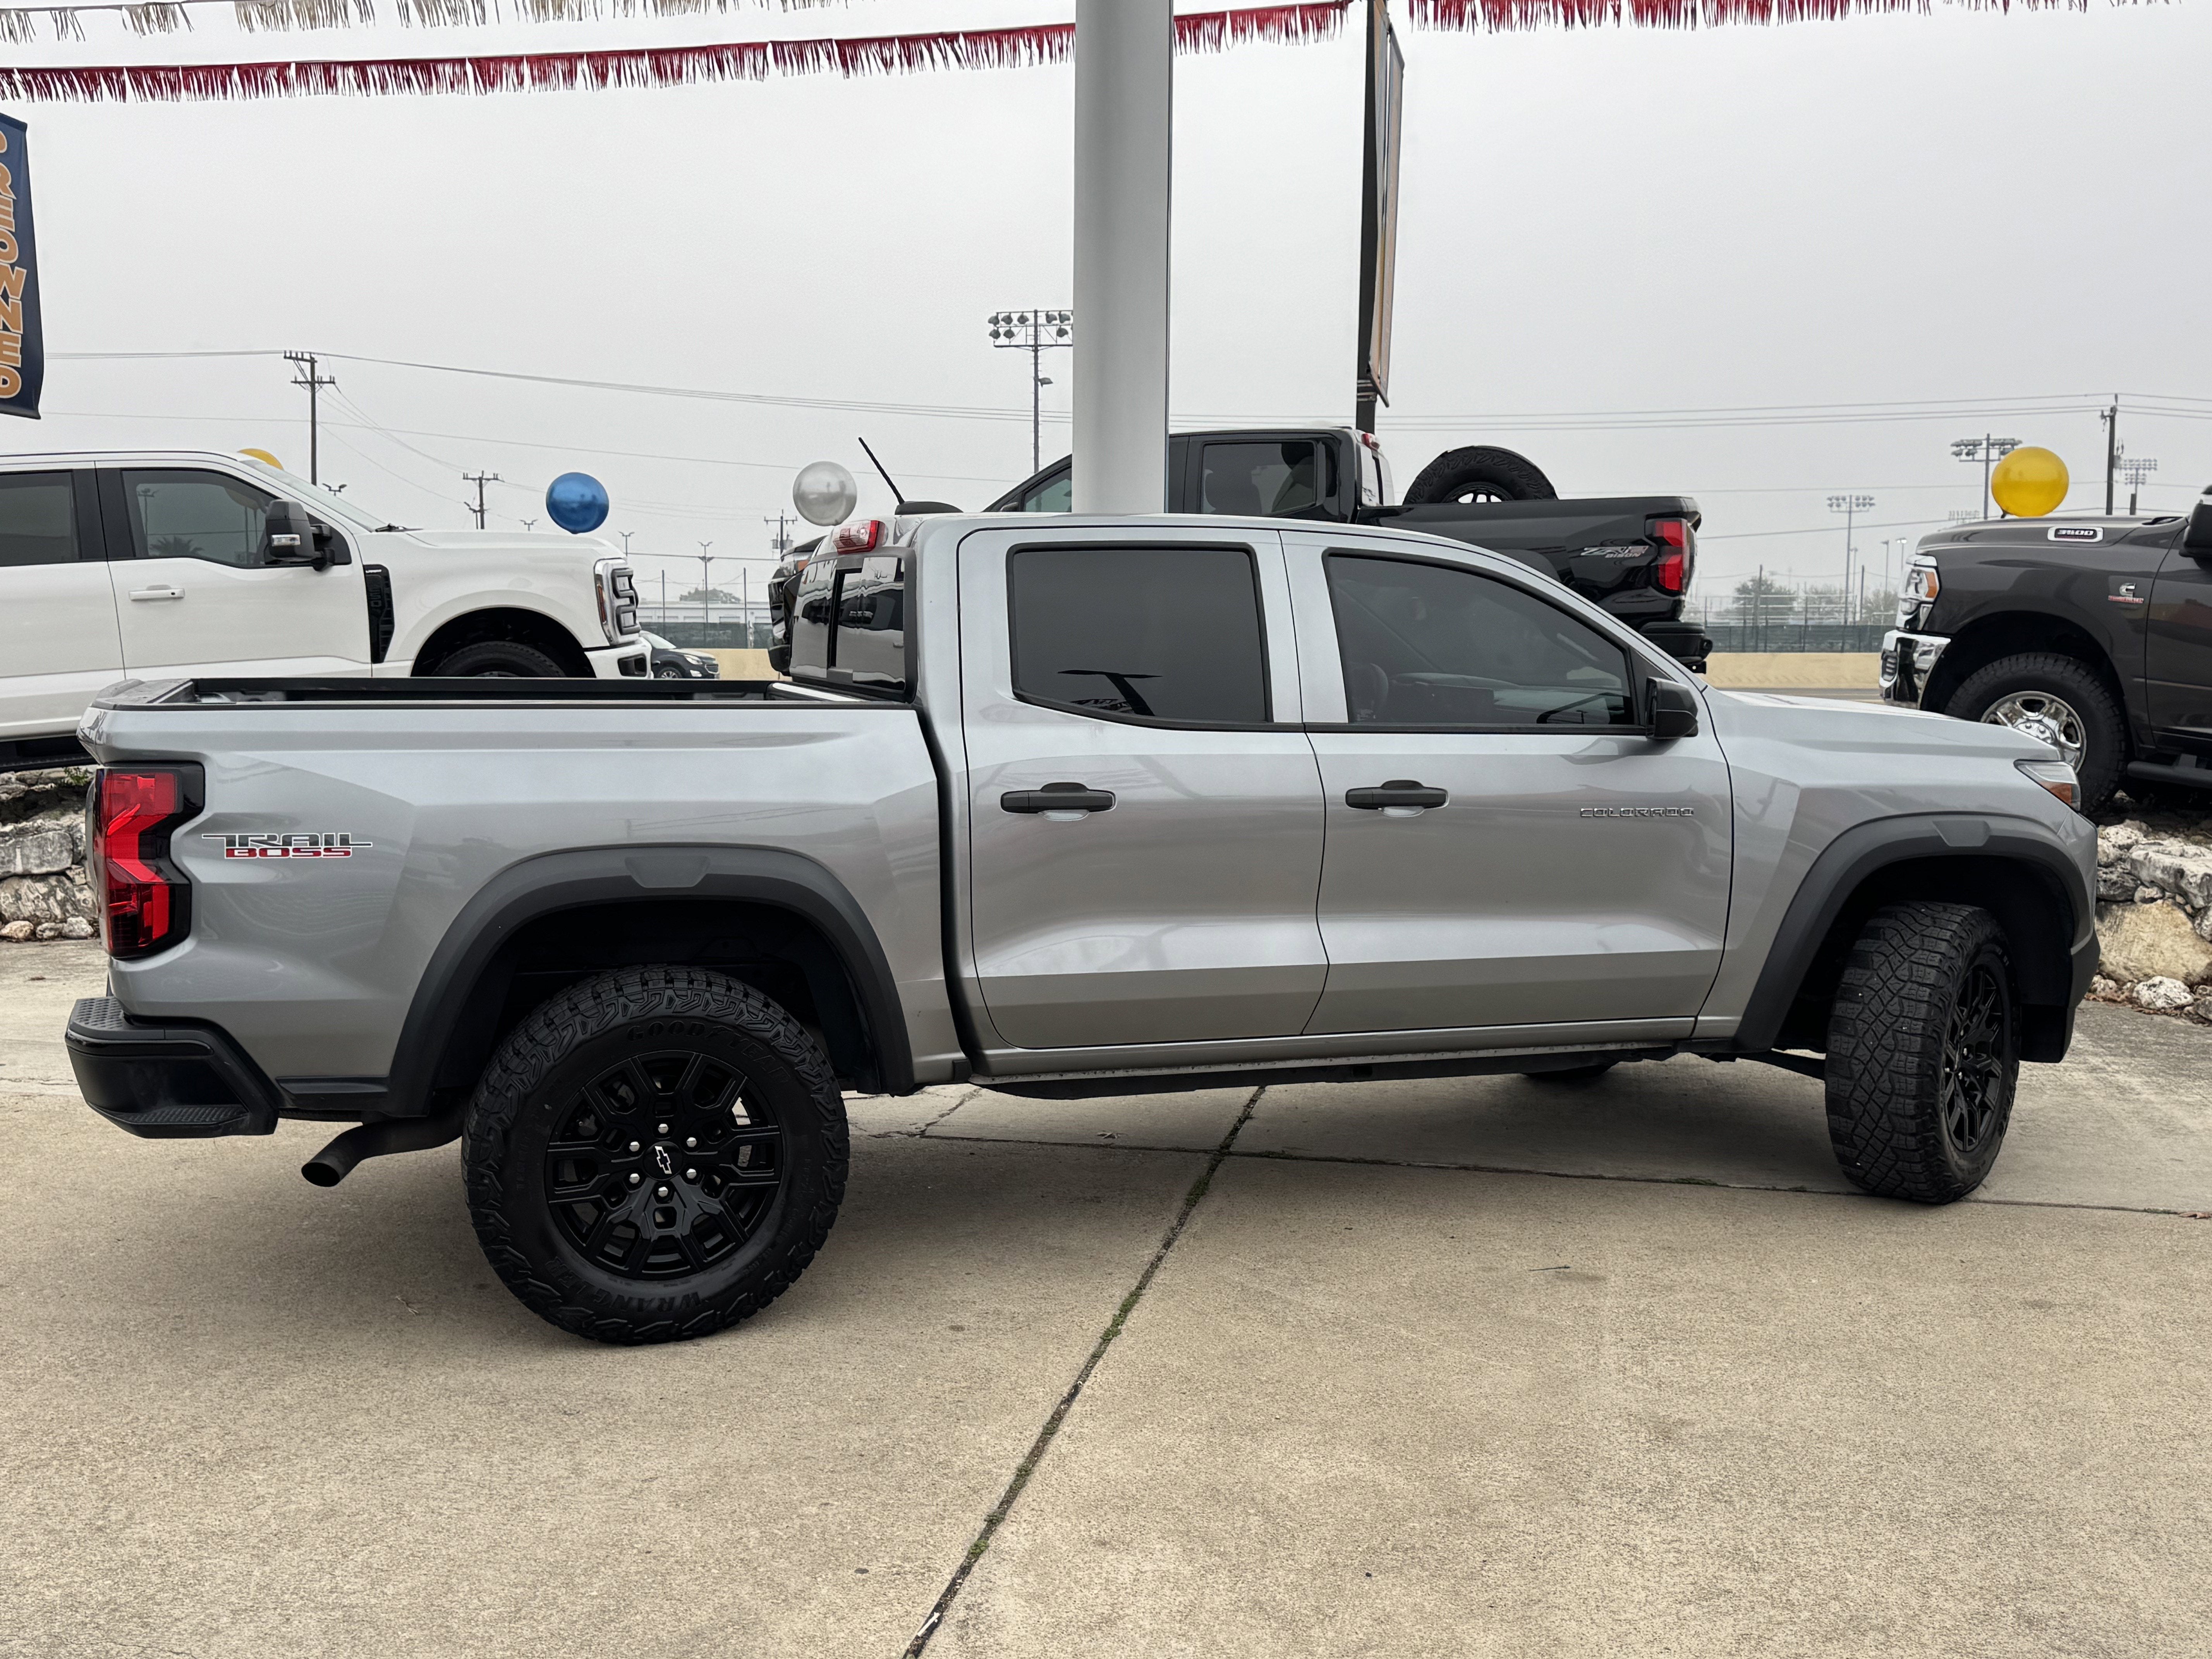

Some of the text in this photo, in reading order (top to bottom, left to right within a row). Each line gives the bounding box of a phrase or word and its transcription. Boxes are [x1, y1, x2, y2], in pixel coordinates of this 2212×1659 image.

[1580, 807, 1695, 817] COLORADO
[201, 833, 373, 847] TRAIL
[224, 846, 353, 859] BOSS
[627, 1020, 792, 1084] GOODYEAR
[544, 1256, 702, 1312] WRANGLER
